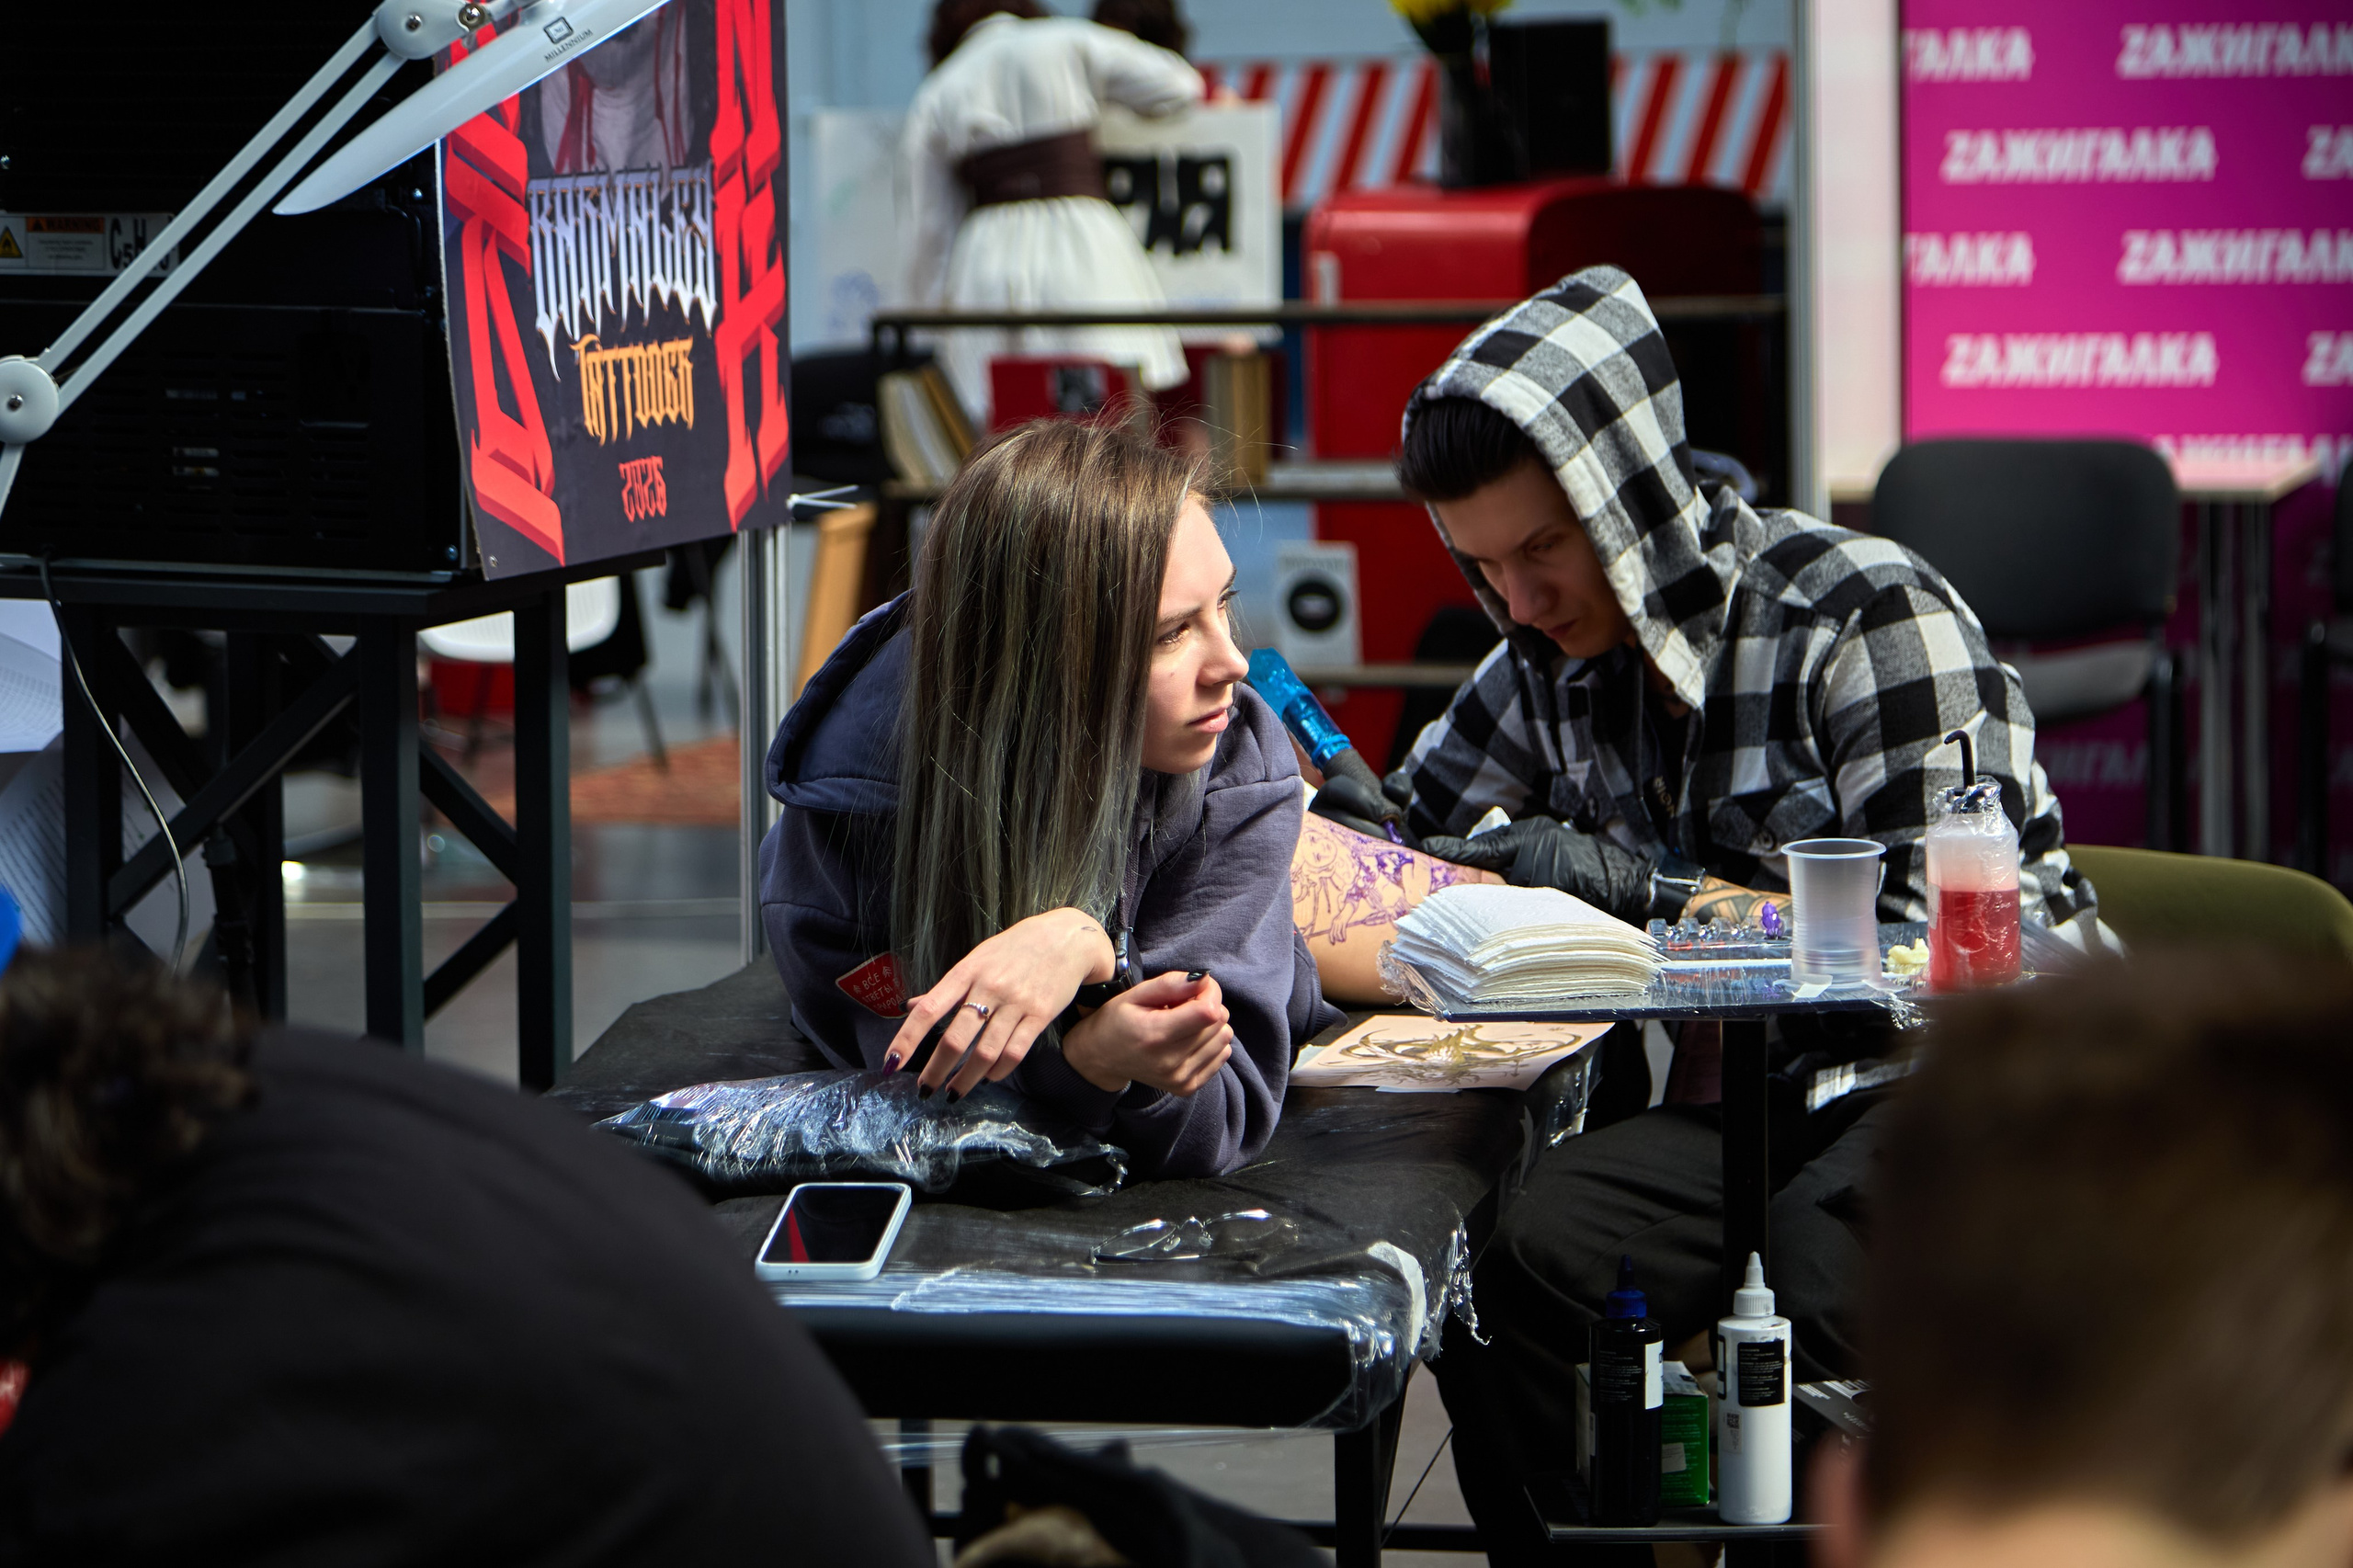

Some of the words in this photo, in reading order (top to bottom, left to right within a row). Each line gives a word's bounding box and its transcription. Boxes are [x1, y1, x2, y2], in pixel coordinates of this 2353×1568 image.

[543, 28, 594, 62] MILLENNIUM
[569, 334, 695, 447] TATTOOER
[862, 972, 881, 991] ВСЕ
